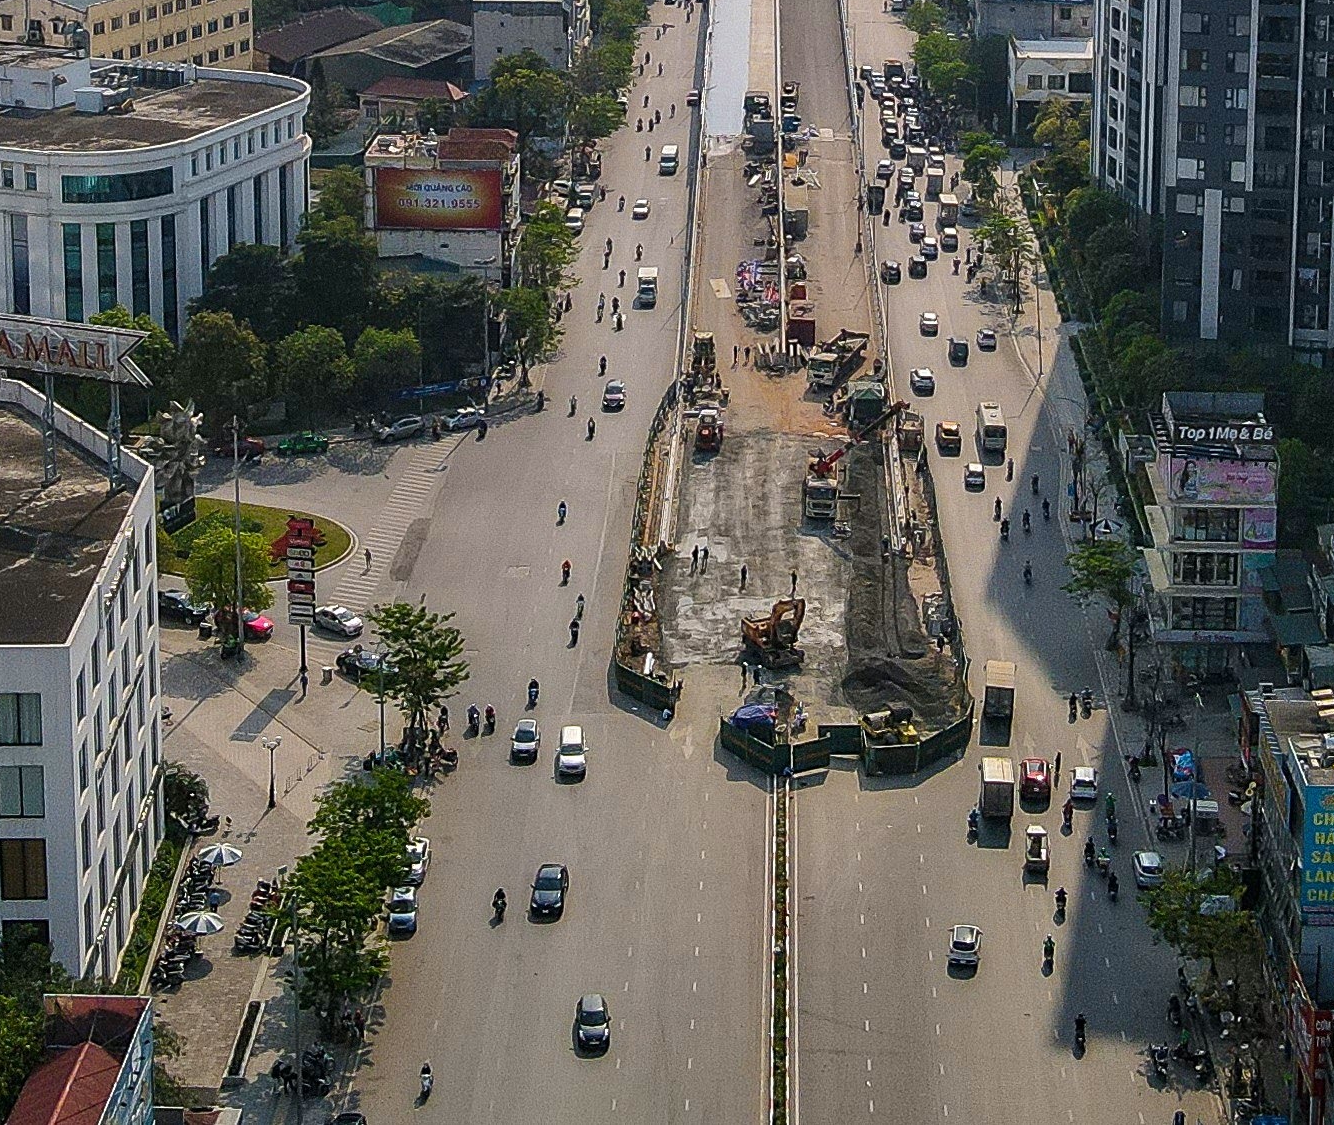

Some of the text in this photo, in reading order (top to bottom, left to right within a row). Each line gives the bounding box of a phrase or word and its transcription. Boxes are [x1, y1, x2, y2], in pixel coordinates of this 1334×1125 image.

[23, 331, 115, 372] MALL
[1178, 426, 1206, 442] Top
[1239, 426, 1250, 440] &
[1252, 426, 1274, 440] Bé
